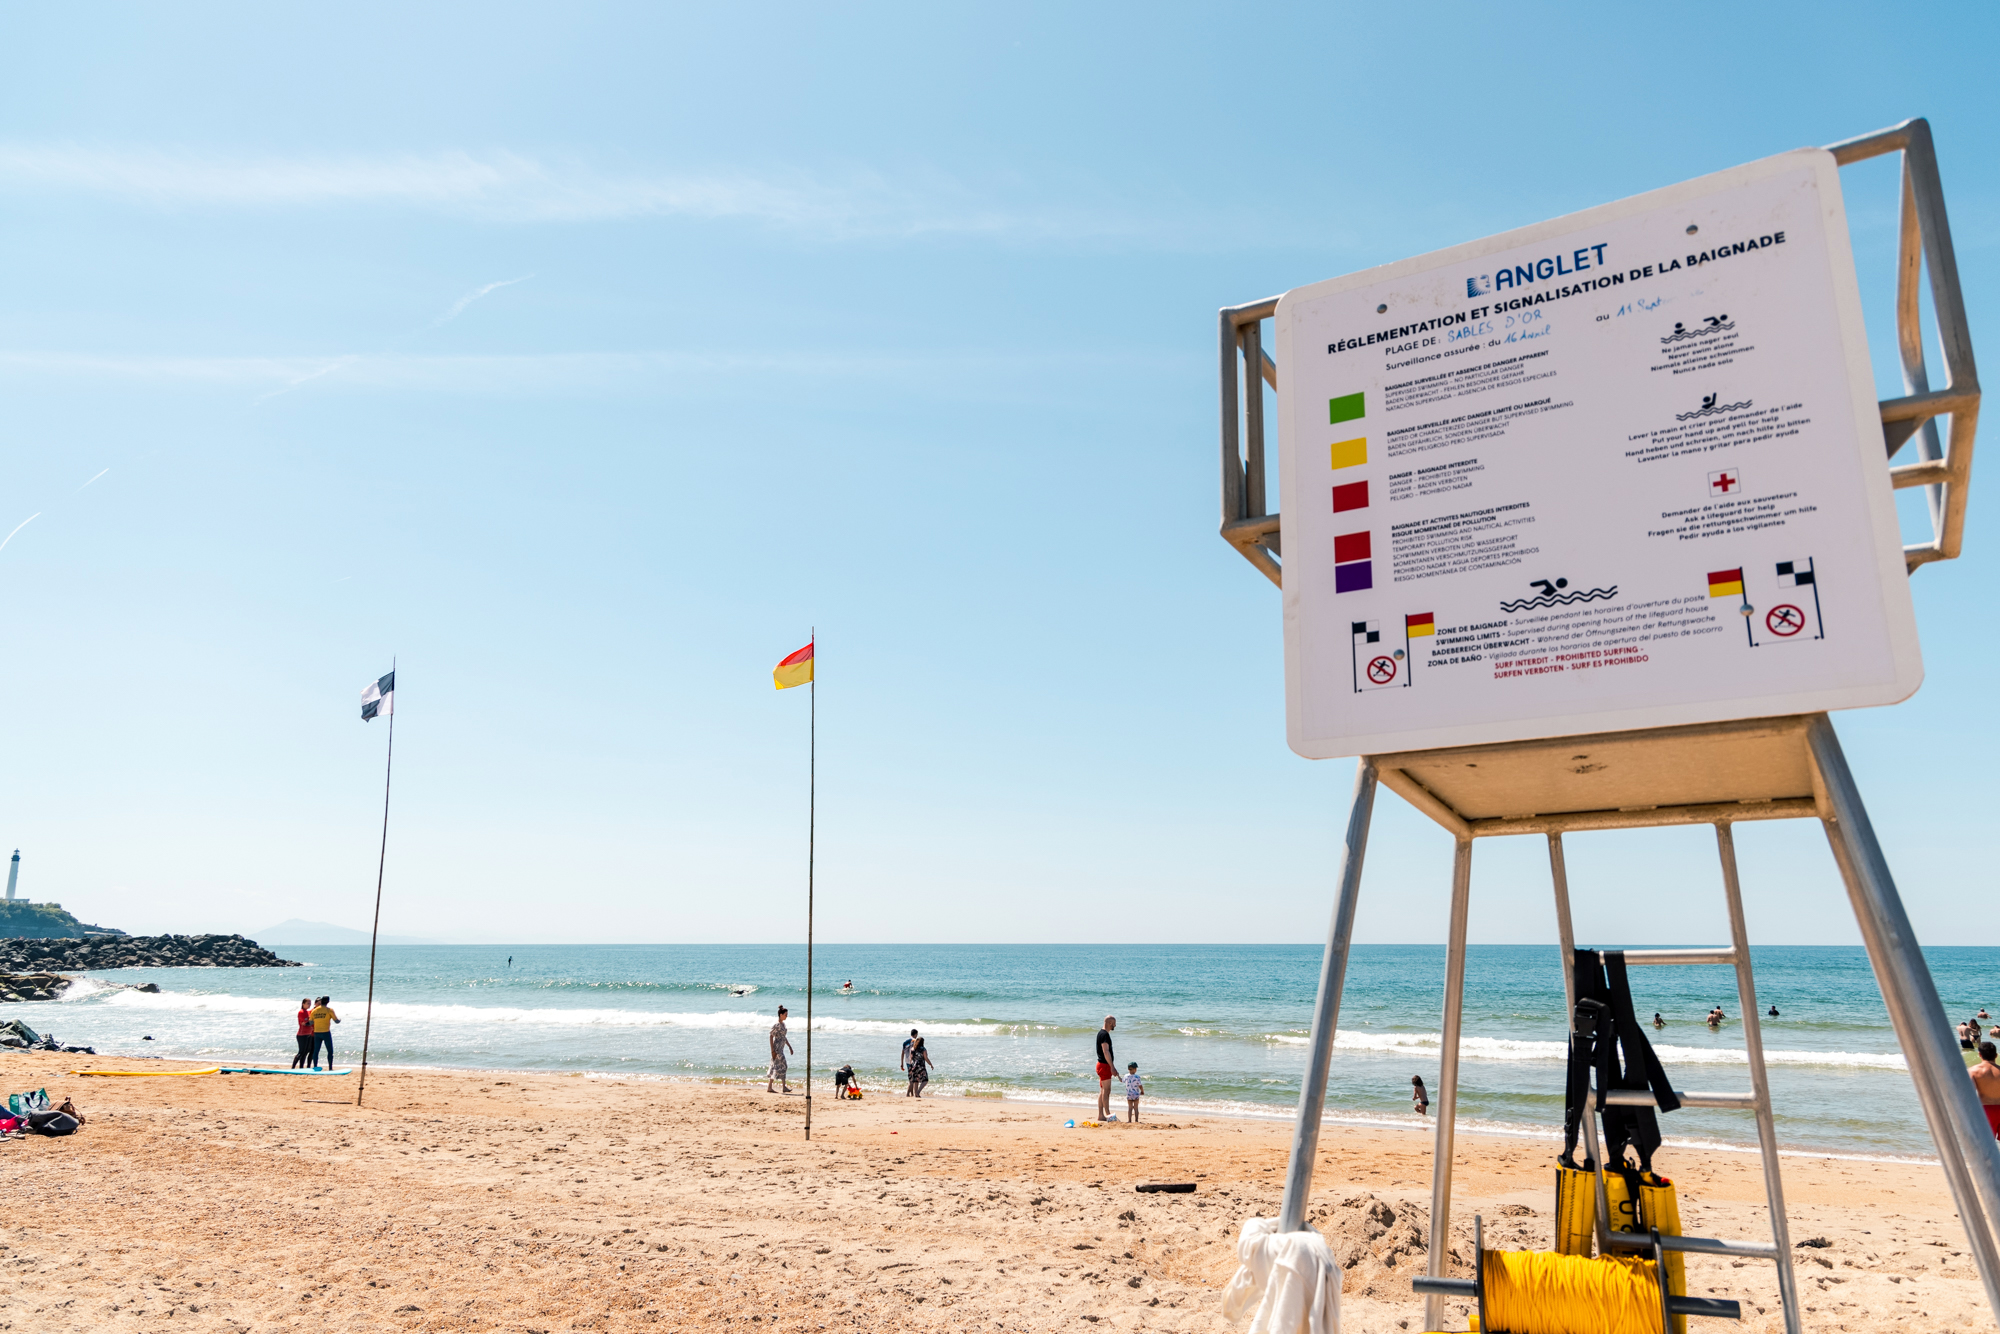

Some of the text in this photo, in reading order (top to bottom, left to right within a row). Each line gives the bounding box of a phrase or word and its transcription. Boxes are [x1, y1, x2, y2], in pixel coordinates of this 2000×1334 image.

[1496, 243, 1608, 291] ANGLET
[1328, 231, 1786, 354] RÉGLEMENTATION ET SIGNALISATION DE LA BAIGNADE
[1596, 314, 1610, 322] au
[1448, 322, 1493, 342] SABLES
[1673, 343, 1697, 352] jamais
[1699, 337, 1720, 345] nager
[1385, 341, 1418, 356] PLAGE
[1386, 339, 1501, 371] Surveillance assurée du
[1651, 346, 1755, 372] Niemals alleine schwimmen
[1668, 342, 1734, 360] Never swim alone
[1385, 381, 1413, 391] BAIGNADE
[1414, 373, 1446, 385] SURVEILLÉE
[1456, 365, 1482, 376] ABSENCE
[1492, 358, 1517, 367] DANGER
[1518, 350, 1548, 361] APPARENT
[1385, 387, 1417, 398] SUPERVISED
[1418, 380, 1448, 391] SWIMMING
[1465, 369, 1498, 380] PARTICULAR
[1500, 363, 1524, 373] DANGER
[1444, 384, 1465, 392] FEHLEN
[1466, 376, 1500, 388] BESONDERE
[1501, 370, 1524, 380] GEFAHR
[1673, 367, 1696, 375] Nunca
[1415, 394, 1452, 406] SUPERVISADA
[1458, 386, 1486, 396] AUSENCIA
[1496, 378, 1522, 388] RIESGOS
[1523, 371, 1557, 382] ESPECIALES
[1387, 426, 1415, 437] BAIGNADE
[1417, 419, 1449, 431] SURVEILLÉE
[1467, 411, 1492, 420] DANGER
[1493, 406, 1512, 415] LIMITÉ
[1524, 398, 1551, 408] MARQUÉ
[1666, 435, 1682, 443] your
[1685, 430, 1703, 438] hand
[1732, 422, 1746, 430] yell
[1389, 459, 1477, 480] DANGER BAIGNADE INTERDITE
[1390, 465, 1485, 487] DANGER PROHIBITED SWIMMING
[1391, 521, 1421, 531] BAIGNADE
[1430, 514, 1459, 524] ACTIVITES
[1460, 508, 1494, 519] NAUTIQUES
[1495, 502, 1530, 512] INTERDITES
[1662, 508, 1700, 518] Demander
[1753, 492, 1797, 503] sauveteurs
[1707, 509, 1742, 519] lifeguard
[1392, 530, 1413, 538] RISQUE
[1414, 523, 1451, 534] MOMENTANÉ
[1462, 516, 1496, 526] POLLUTION
[1392, 535, 1425, 545] PROHIBITED
[1427, 530, 1458, 539] SWIMMING
[1473, 523, 1502, 531] NAUTICAL
[1504, 516, 1536, 527] ACTIVITIES
[1436, 635, 1475, 646] SWIMMING
[1477, 632, 1501, 641] LIMITS
[1508, 626, 1545, 637] Supervised
[1572, 620, 1601, 629] opening
[1649, 608, 1683, 618] lifeguard
[1437, 627, 1456, 636] ZONE
[1470, 620, 1508, 631] BAIGNADE
[1515, 616, 1548, 625] Surveillée
[1550, 611, 1580, 621] pendant
[1594, 606, 1624, 614] horaires
[1626, 600, 1670, 610] d'ouverture
[1684, 595, 1705, 604] poste
[1428, 659, 1448, 667] ZONA
[1461, 654, 1482, 663] BAÑO
[1489, 651, 1517, 660] Vigilada
[1519, 648, 1547, 656] durante
[1560, 643, 1590, 651] horarios
[1604, 637, 1637, 646] apertura
[1653, 632, 1679, 641] puesto
[1693, 626, 1723, 635] socorro
[1432, 645, 1481, 656] BADEBEREICH
[1658, 616, 1715, 628] Rettungswache
[1494, 655, 1649, 679] SURFEN VERBOTEN SURF ES PROHIBIDO
[1495, 646, 1638, 669] SURF INTERDIT PROHIBITED SURFING
